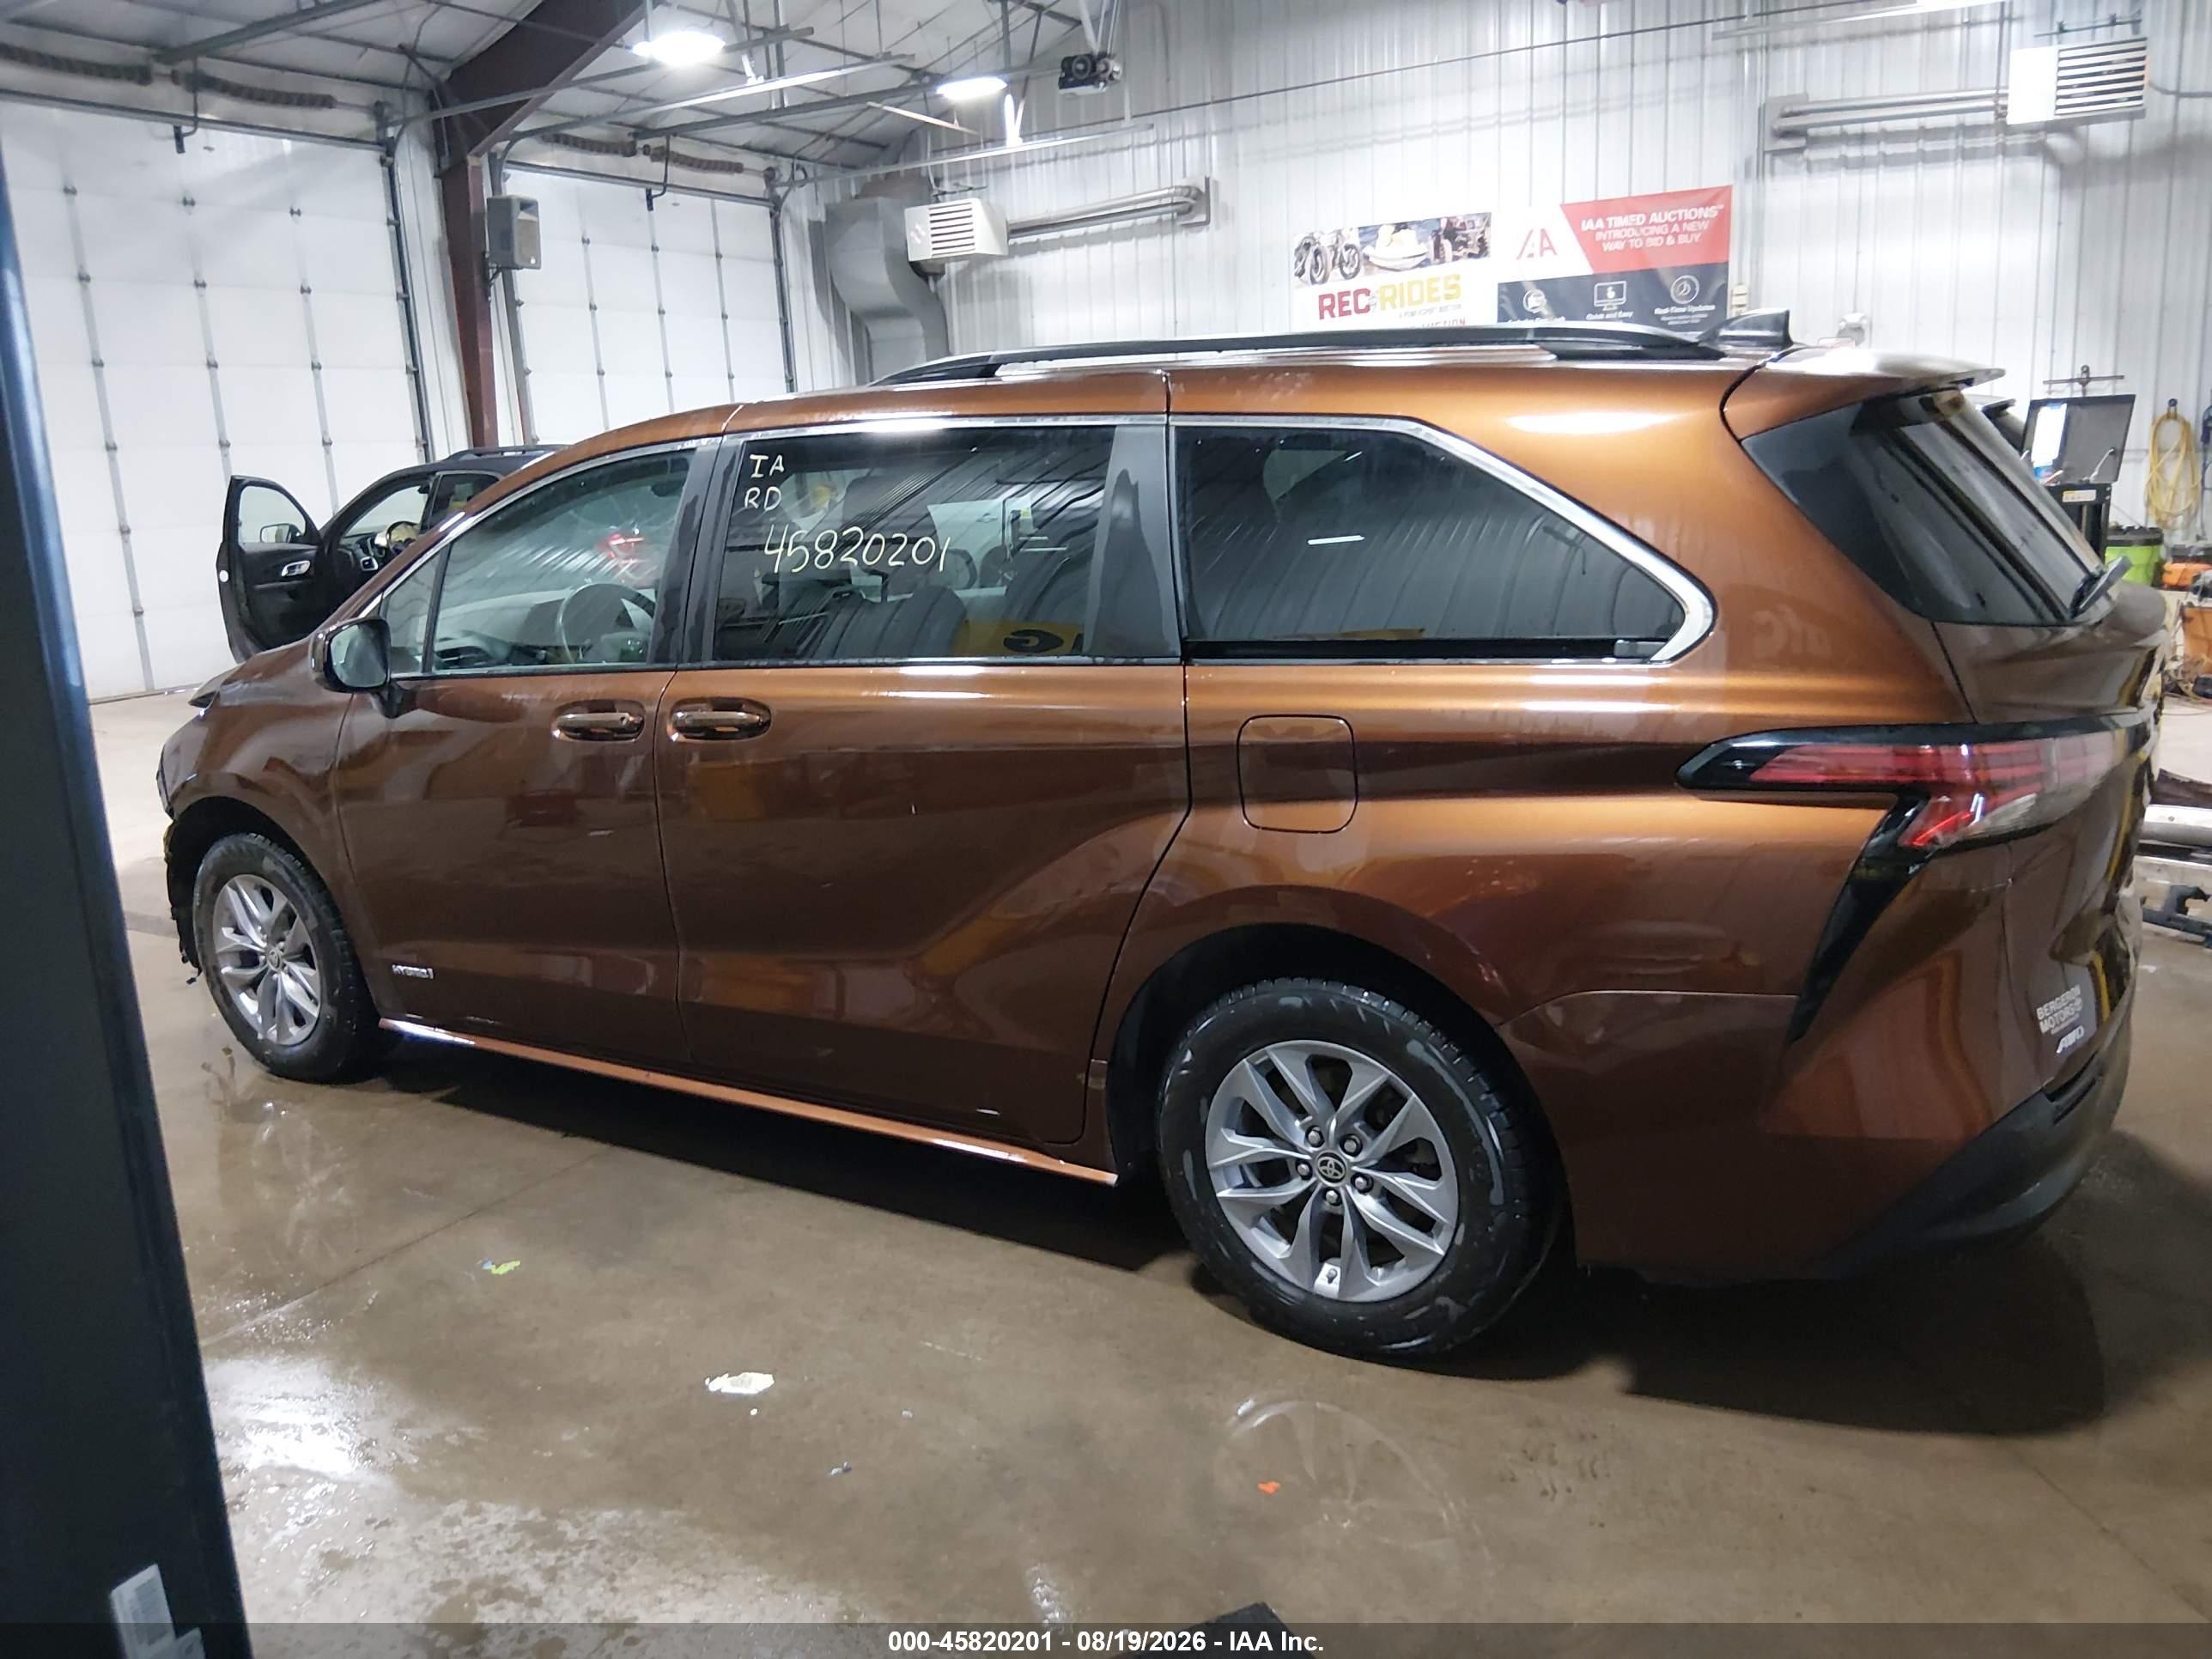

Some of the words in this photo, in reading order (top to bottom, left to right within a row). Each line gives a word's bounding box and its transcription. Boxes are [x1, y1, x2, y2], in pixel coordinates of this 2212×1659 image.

[1581, 217, 1604, 231] IAA
[1607, 213, 1646, 228] TIMED
[1595, 224, 1668, 241] INTRODUCING
[1670, 223, 1680, 234] A
[1682, 220, 1711, 232] NEW
[1601, 240, 1626, 252] WAY
[1629, 238, 1644, 249] TO
[1645, 236, 1664, 248] BID
[1666, 234, 1676, 246] &
[1678, 233, 1702, 245] BUY
[1318, 288, 1371, 320] REC
[1378, 274, 1462, 312] RIDES
[749, 453, 786, 479] IA
[744, 486, 782, 511] RD
[763, 523, 951, 574] 45820201
